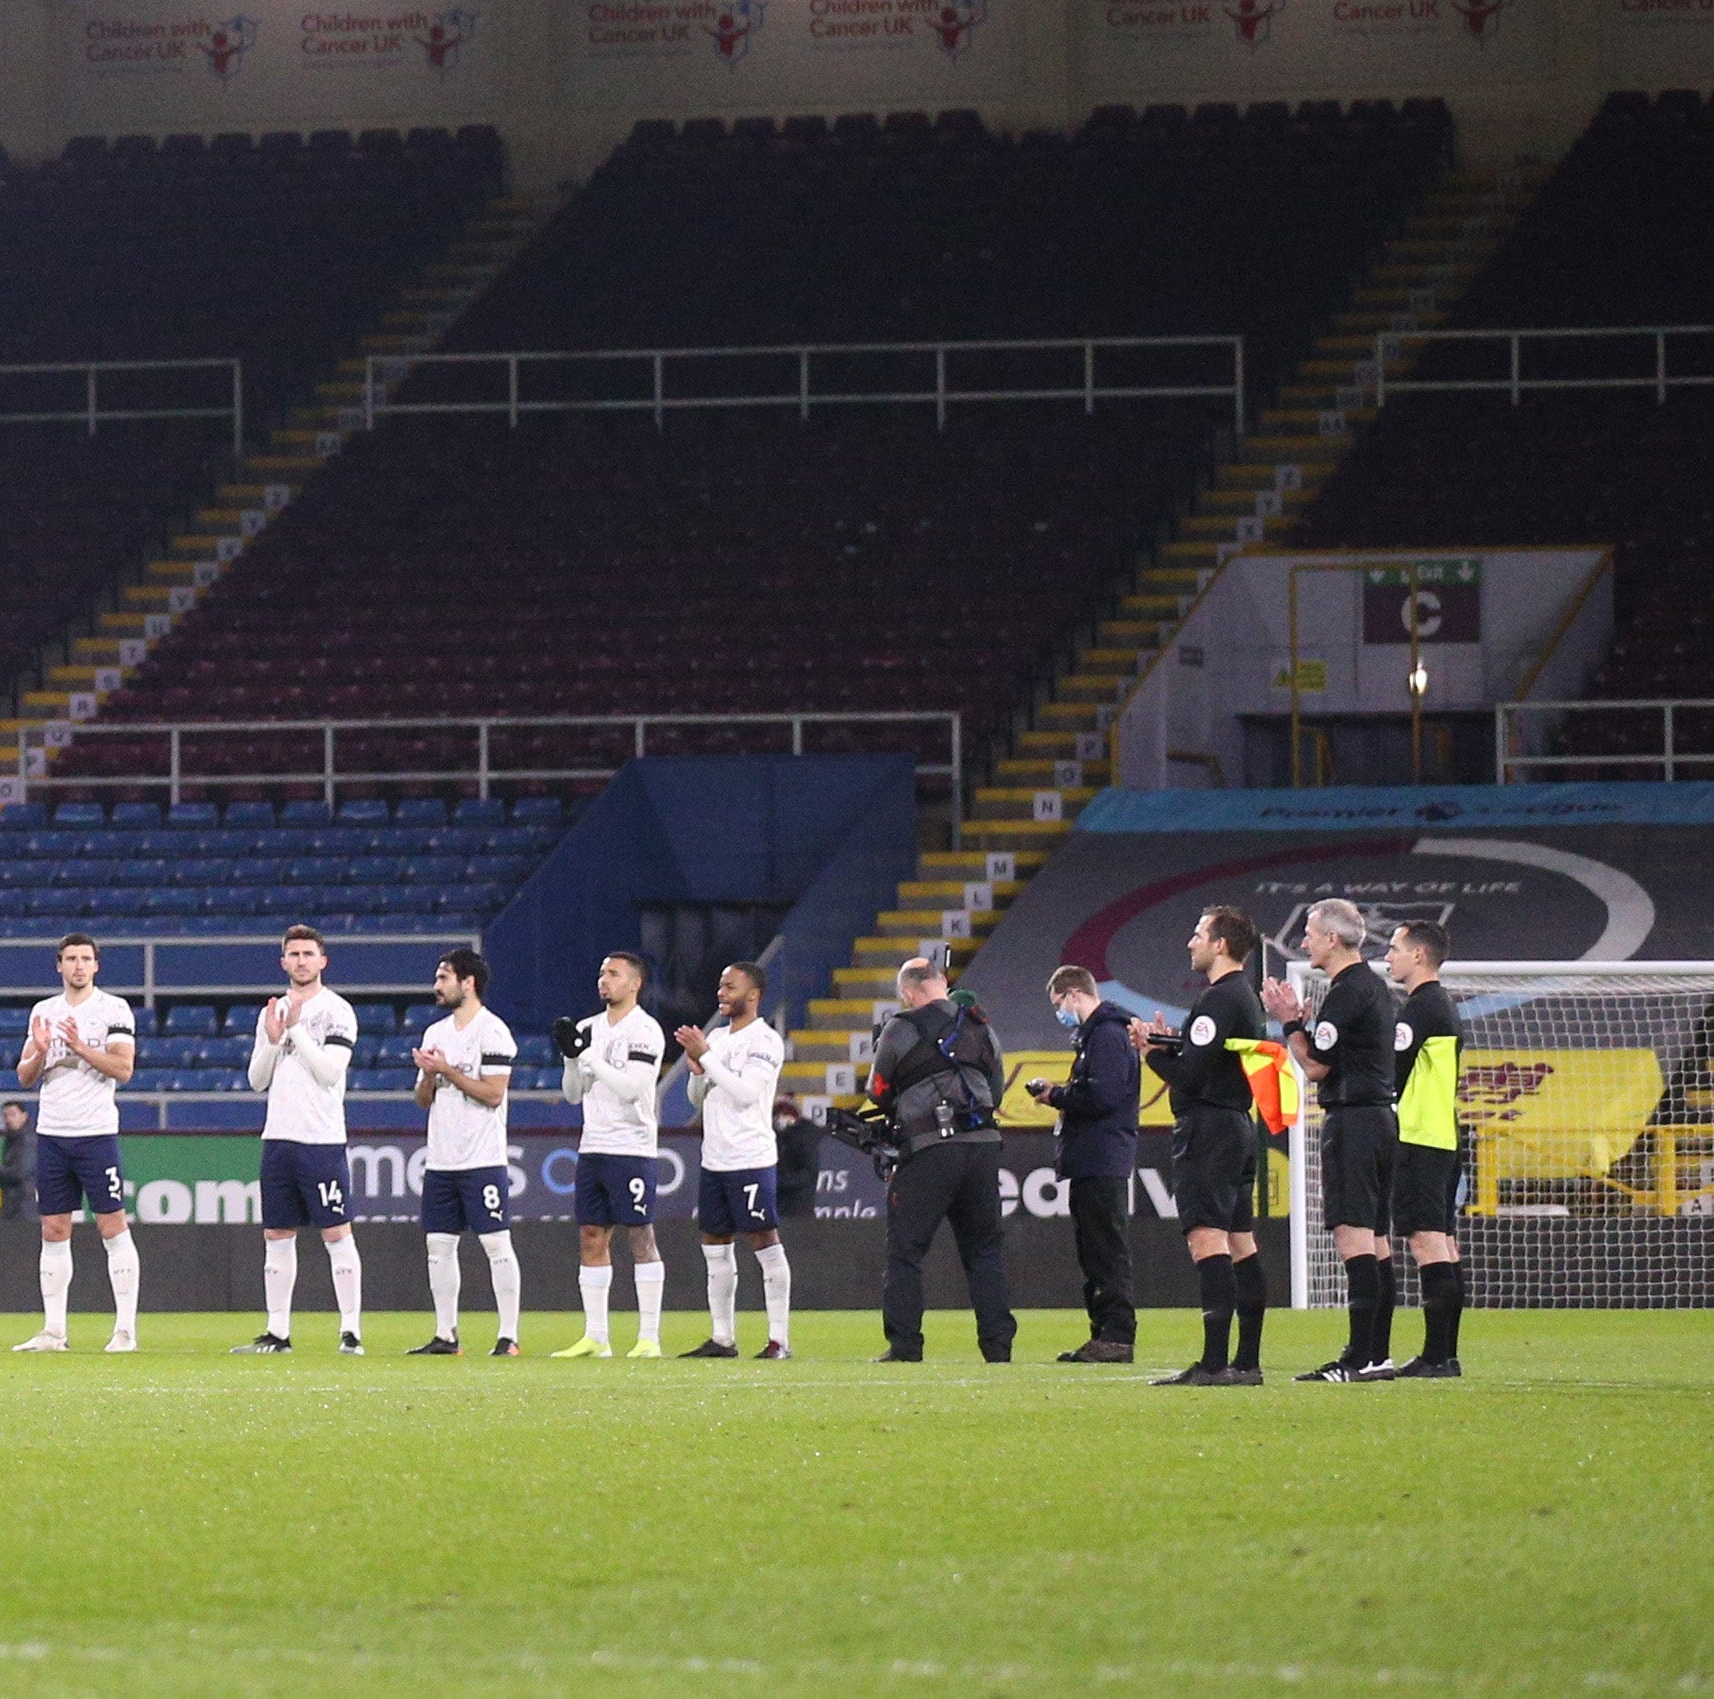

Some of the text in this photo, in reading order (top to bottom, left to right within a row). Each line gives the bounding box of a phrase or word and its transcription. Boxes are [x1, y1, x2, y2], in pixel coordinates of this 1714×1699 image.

[1401, 591, 1441, 636] C
[105, 1166, 120, 1195] 3
[317, 1179, 343, 1206] 14
[628, 1176, 646, 1203] 9
[481, 1182, 501, 1210] 8
[742, 1182, 760, 1210] 7
